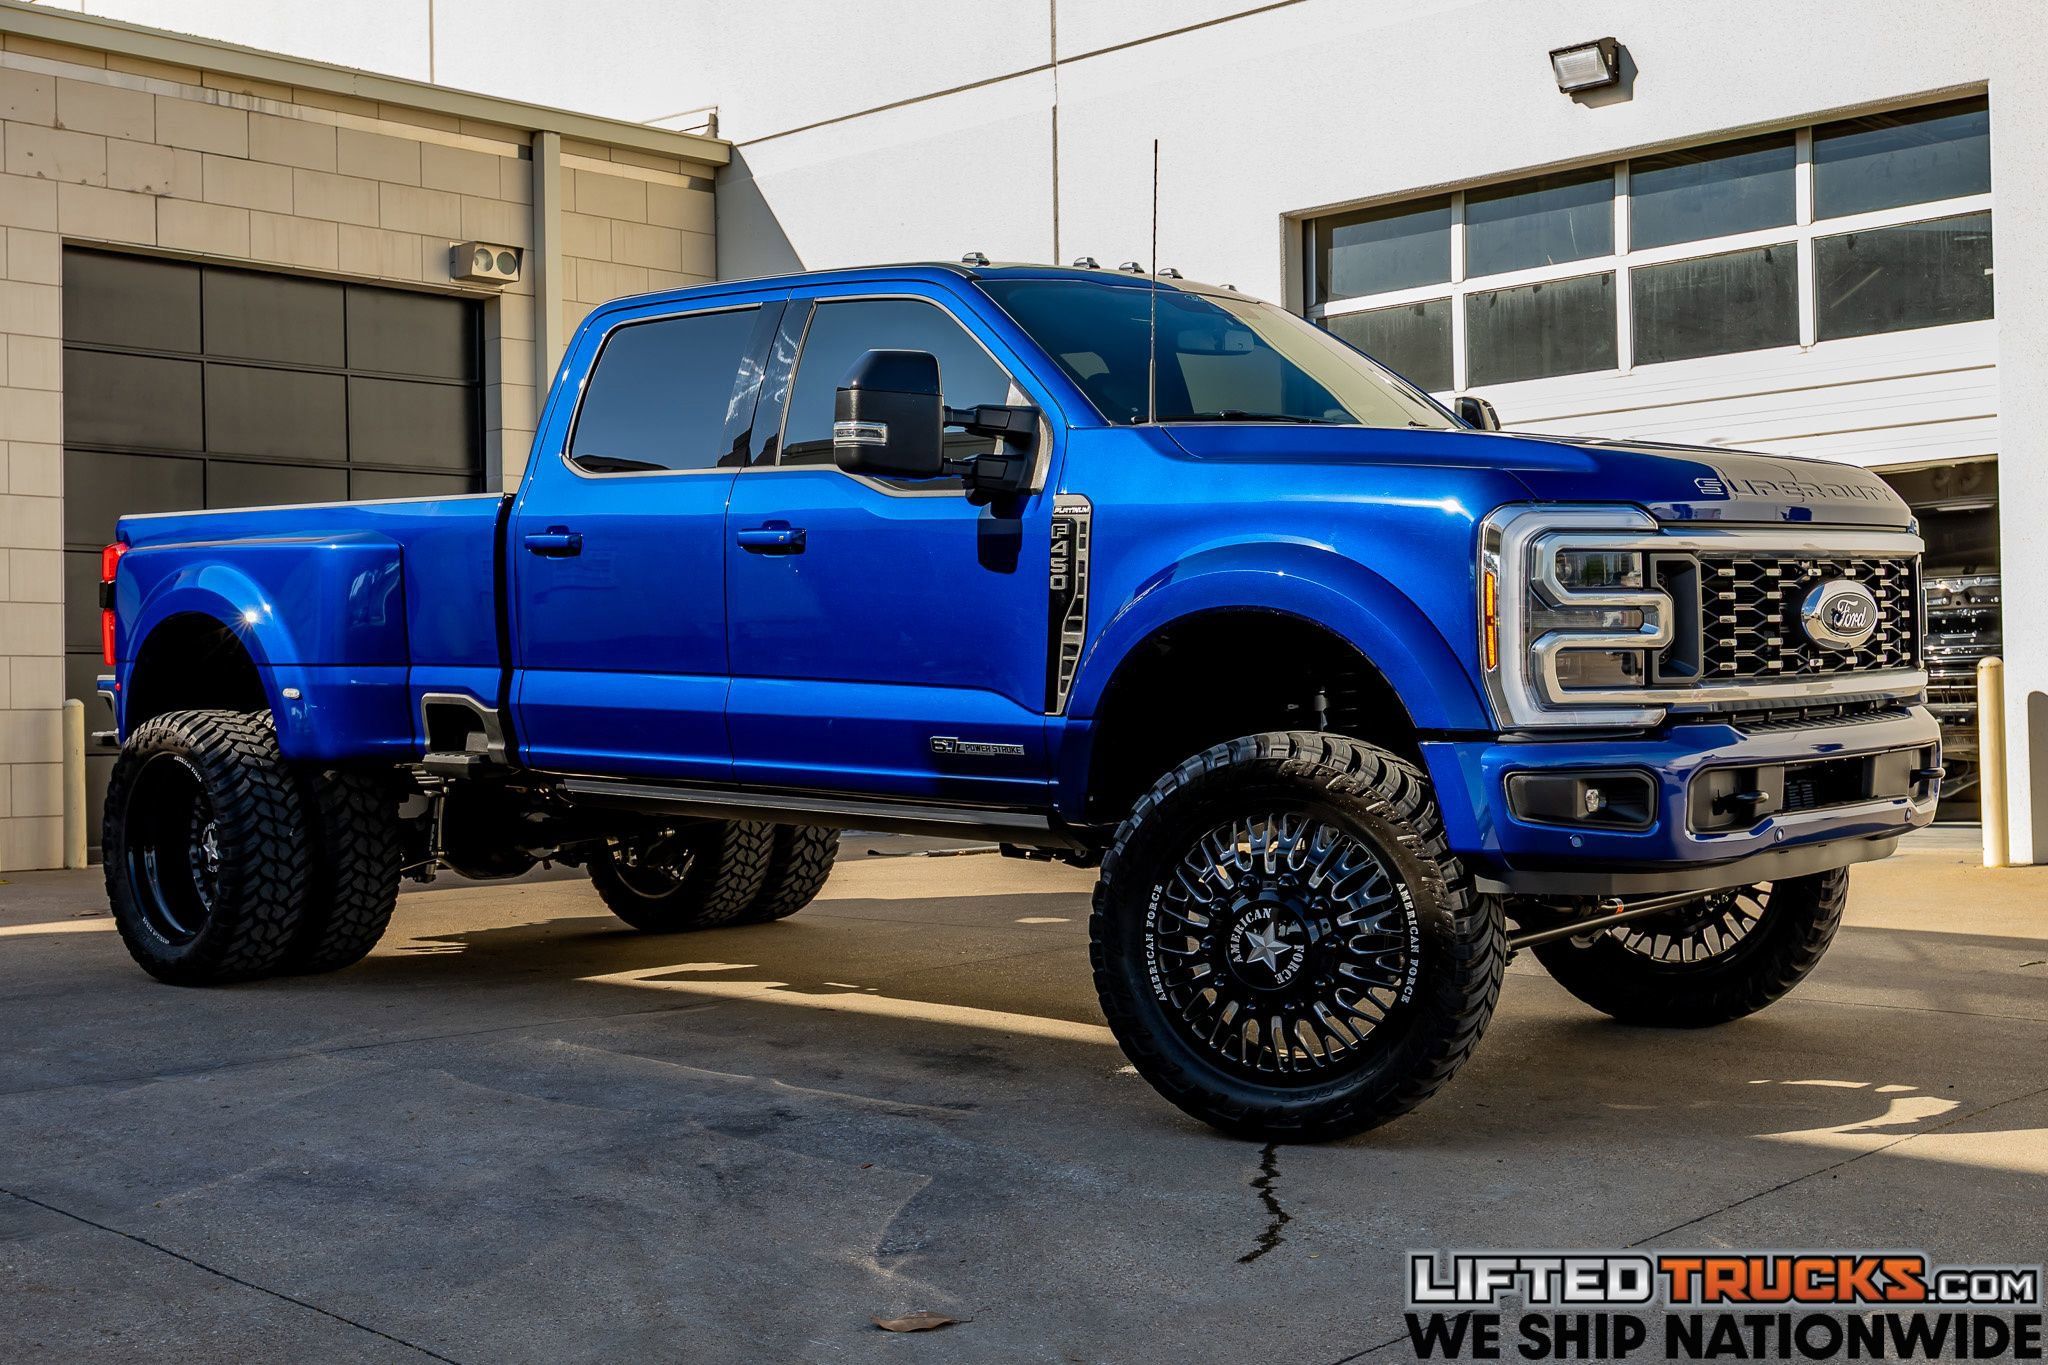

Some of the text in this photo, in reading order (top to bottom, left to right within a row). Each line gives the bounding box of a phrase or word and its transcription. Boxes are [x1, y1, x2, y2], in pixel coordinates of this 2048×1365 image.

[1053, 506, 1090, 514] PLATINUM
[1050, 523, 1069, 590] F450
[1833, 600, 1867, 628] Ford
[965, 743, 991, 754] POWER
[992, 745, 1022, 755] STROKE
[1145, 884, 1168, 1001] AMERICAN FORCE
[1230, 907, 1305, 984] AMERICAN FORCE
[1396, 883, 1420, 1004] AMERICAN FORCE
